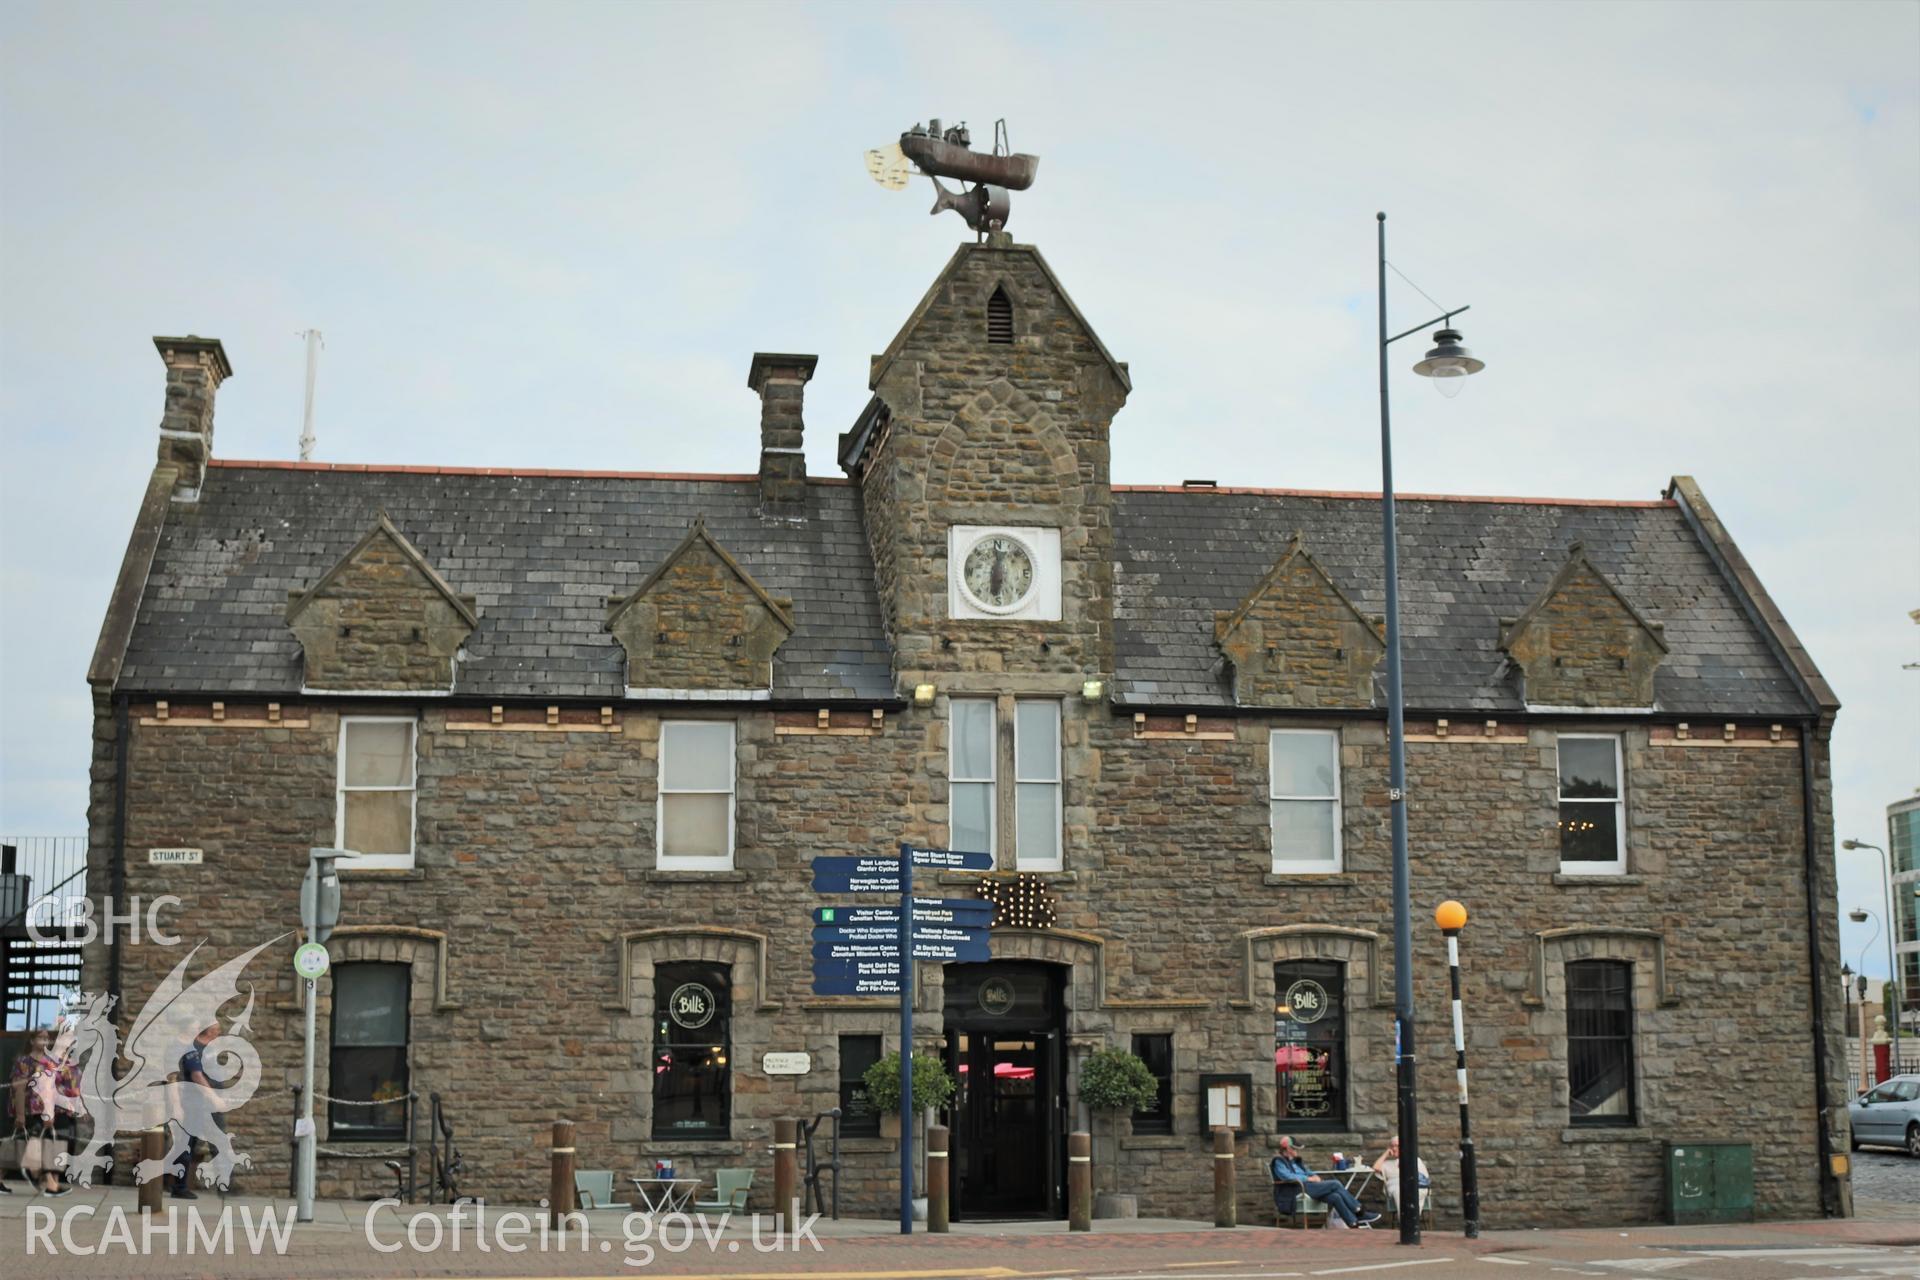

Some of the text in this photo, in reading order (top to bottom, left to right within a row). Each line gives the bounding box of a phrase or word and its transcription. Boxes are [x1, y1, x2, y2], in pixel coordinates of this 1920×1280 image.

[994, 540, 1002, 550] N
[965, 568, 974, 577] W
[1023, 569, 1030, 579] E
[995, 597, 1002, 605] S
[153, 851, 186, 861] STUART
[678, 995, 704, 1014] Bill's
[1294, 992, 1318, 1009] Bill's
